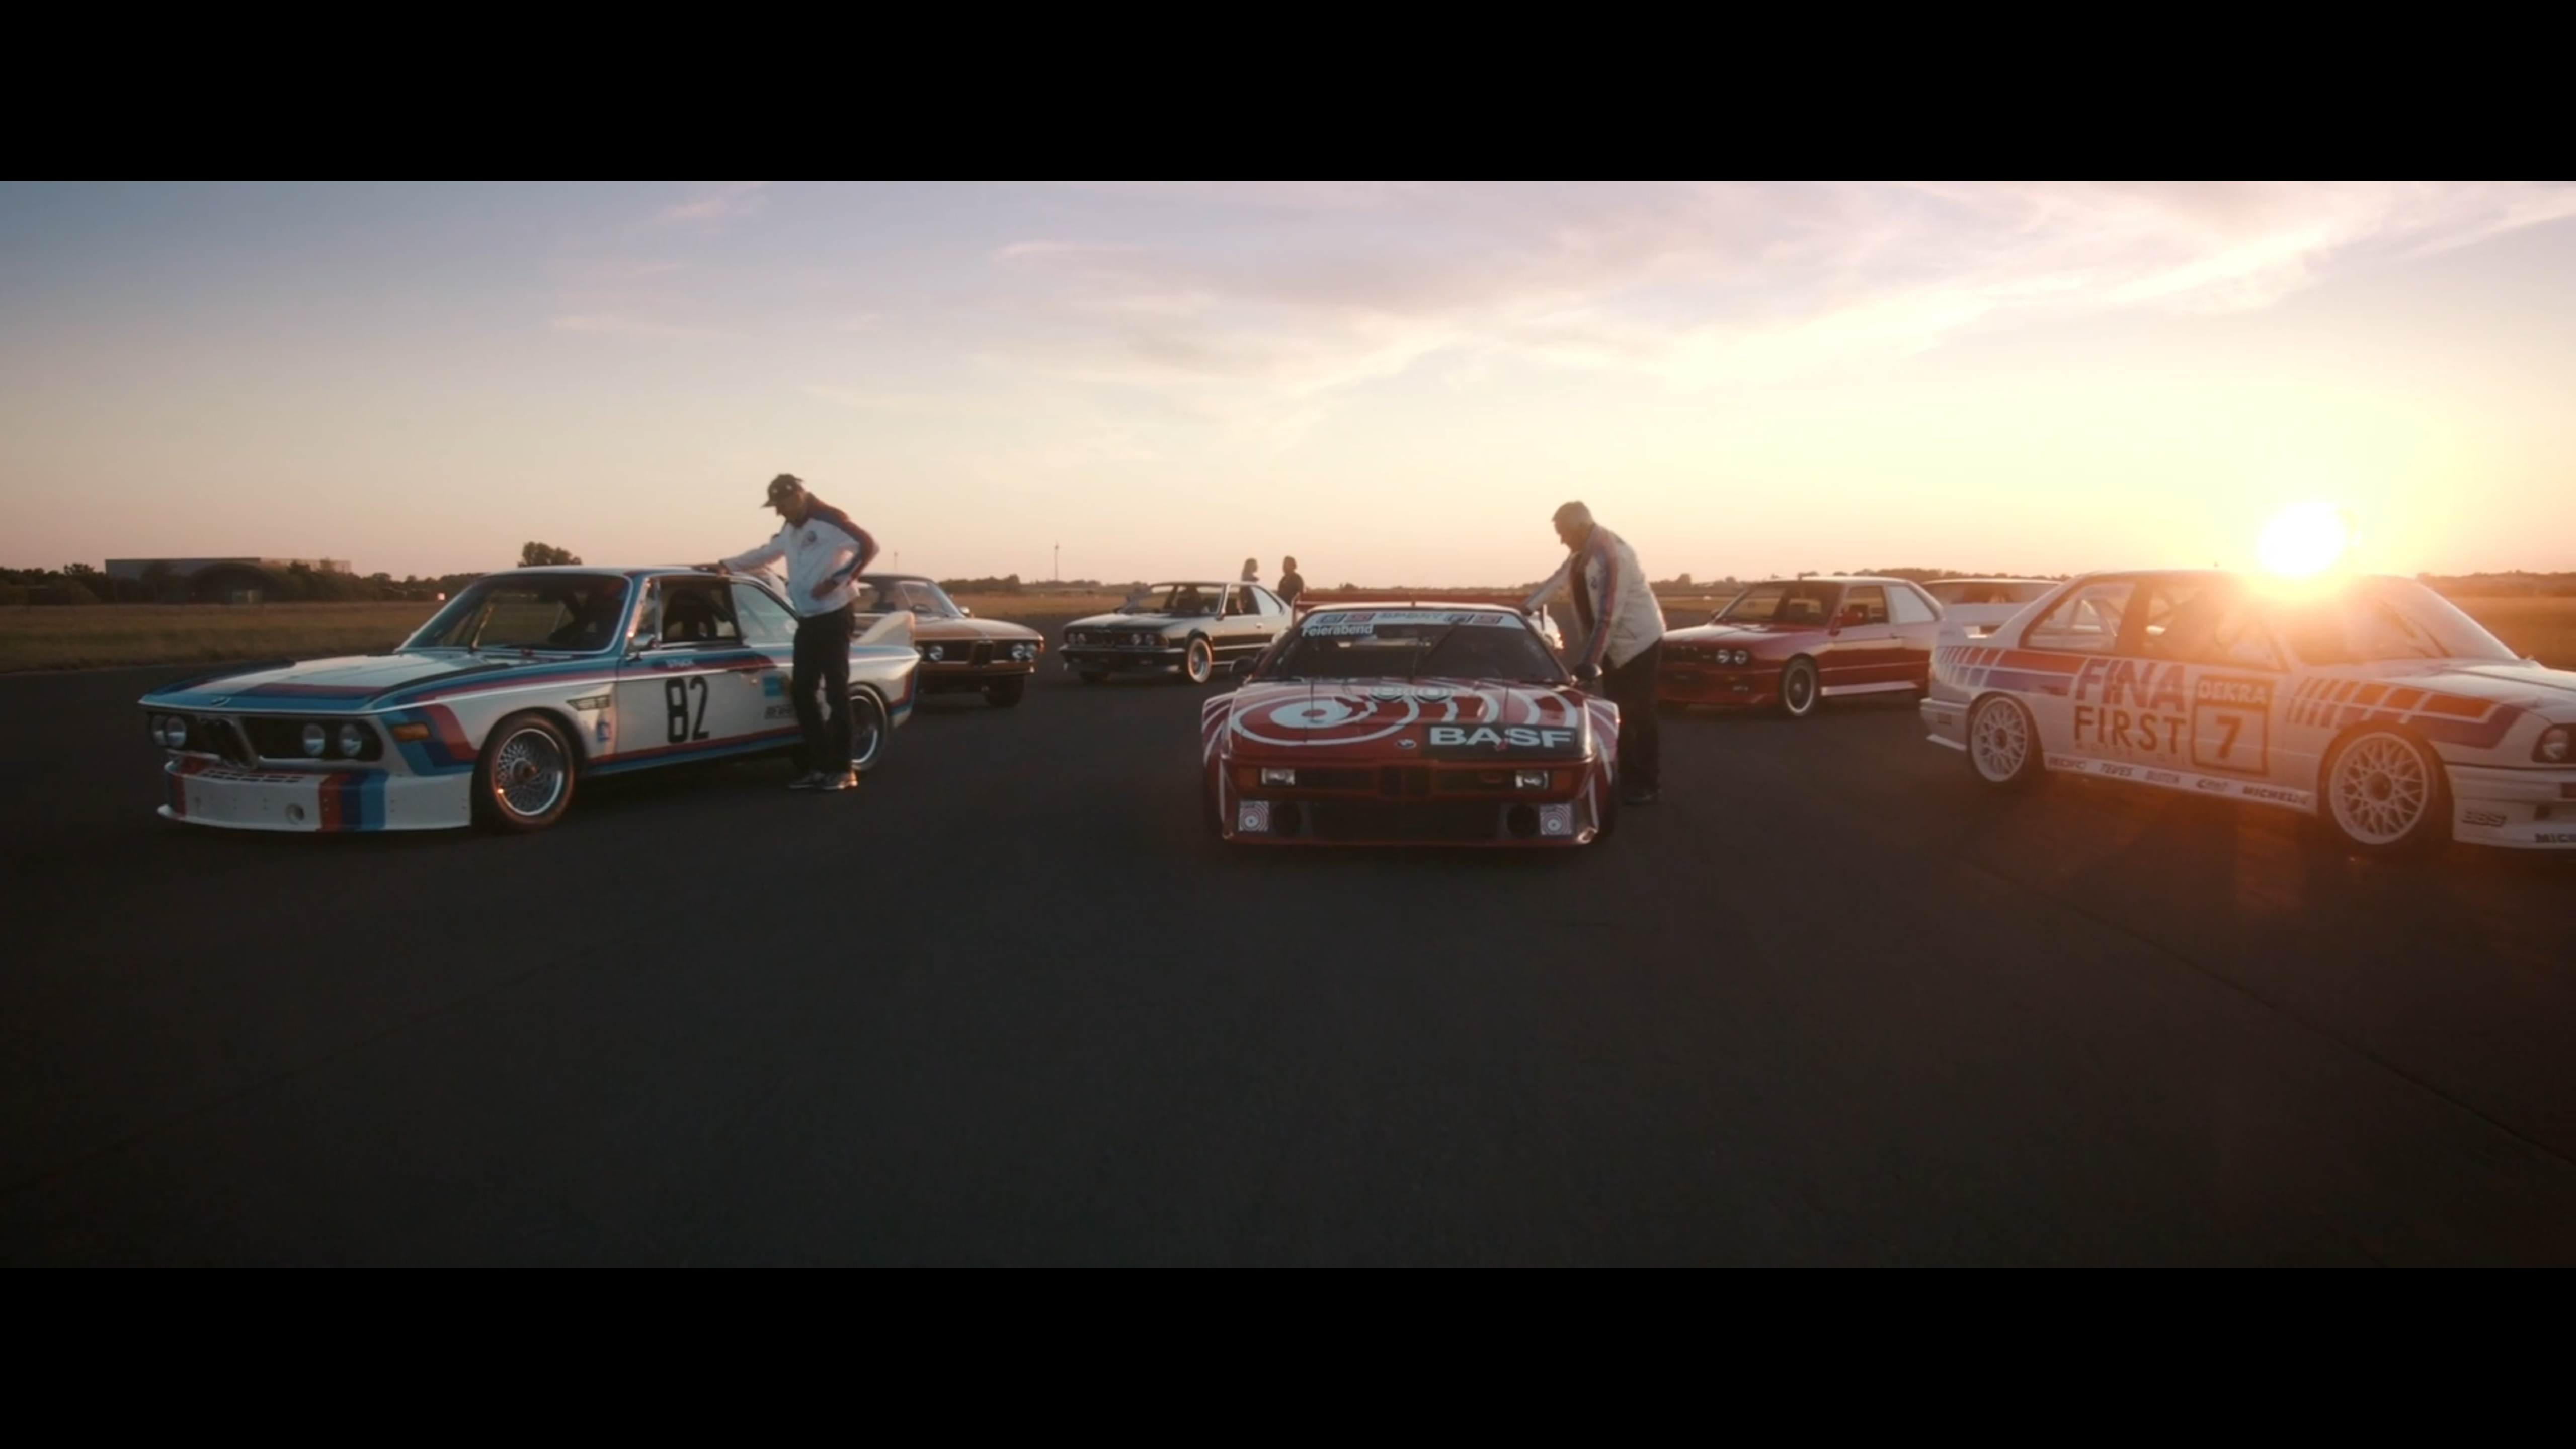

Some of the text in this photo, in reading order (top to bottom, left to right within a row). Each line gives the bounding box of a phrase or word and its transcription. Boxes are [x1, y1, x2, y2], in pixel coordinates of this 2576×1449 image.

[1301, 624, 1374, 637] Feierabend
[2076, 657, 2185, 712] FINA
[2197, 680, 2268, 703] DEKRA
[665, 676, 709, 743] 82
[2074, 705, 2186, 754] FIRST
[1430, 727, 1572, 748] BASF
[2216, 715, 2242, 759] 7
